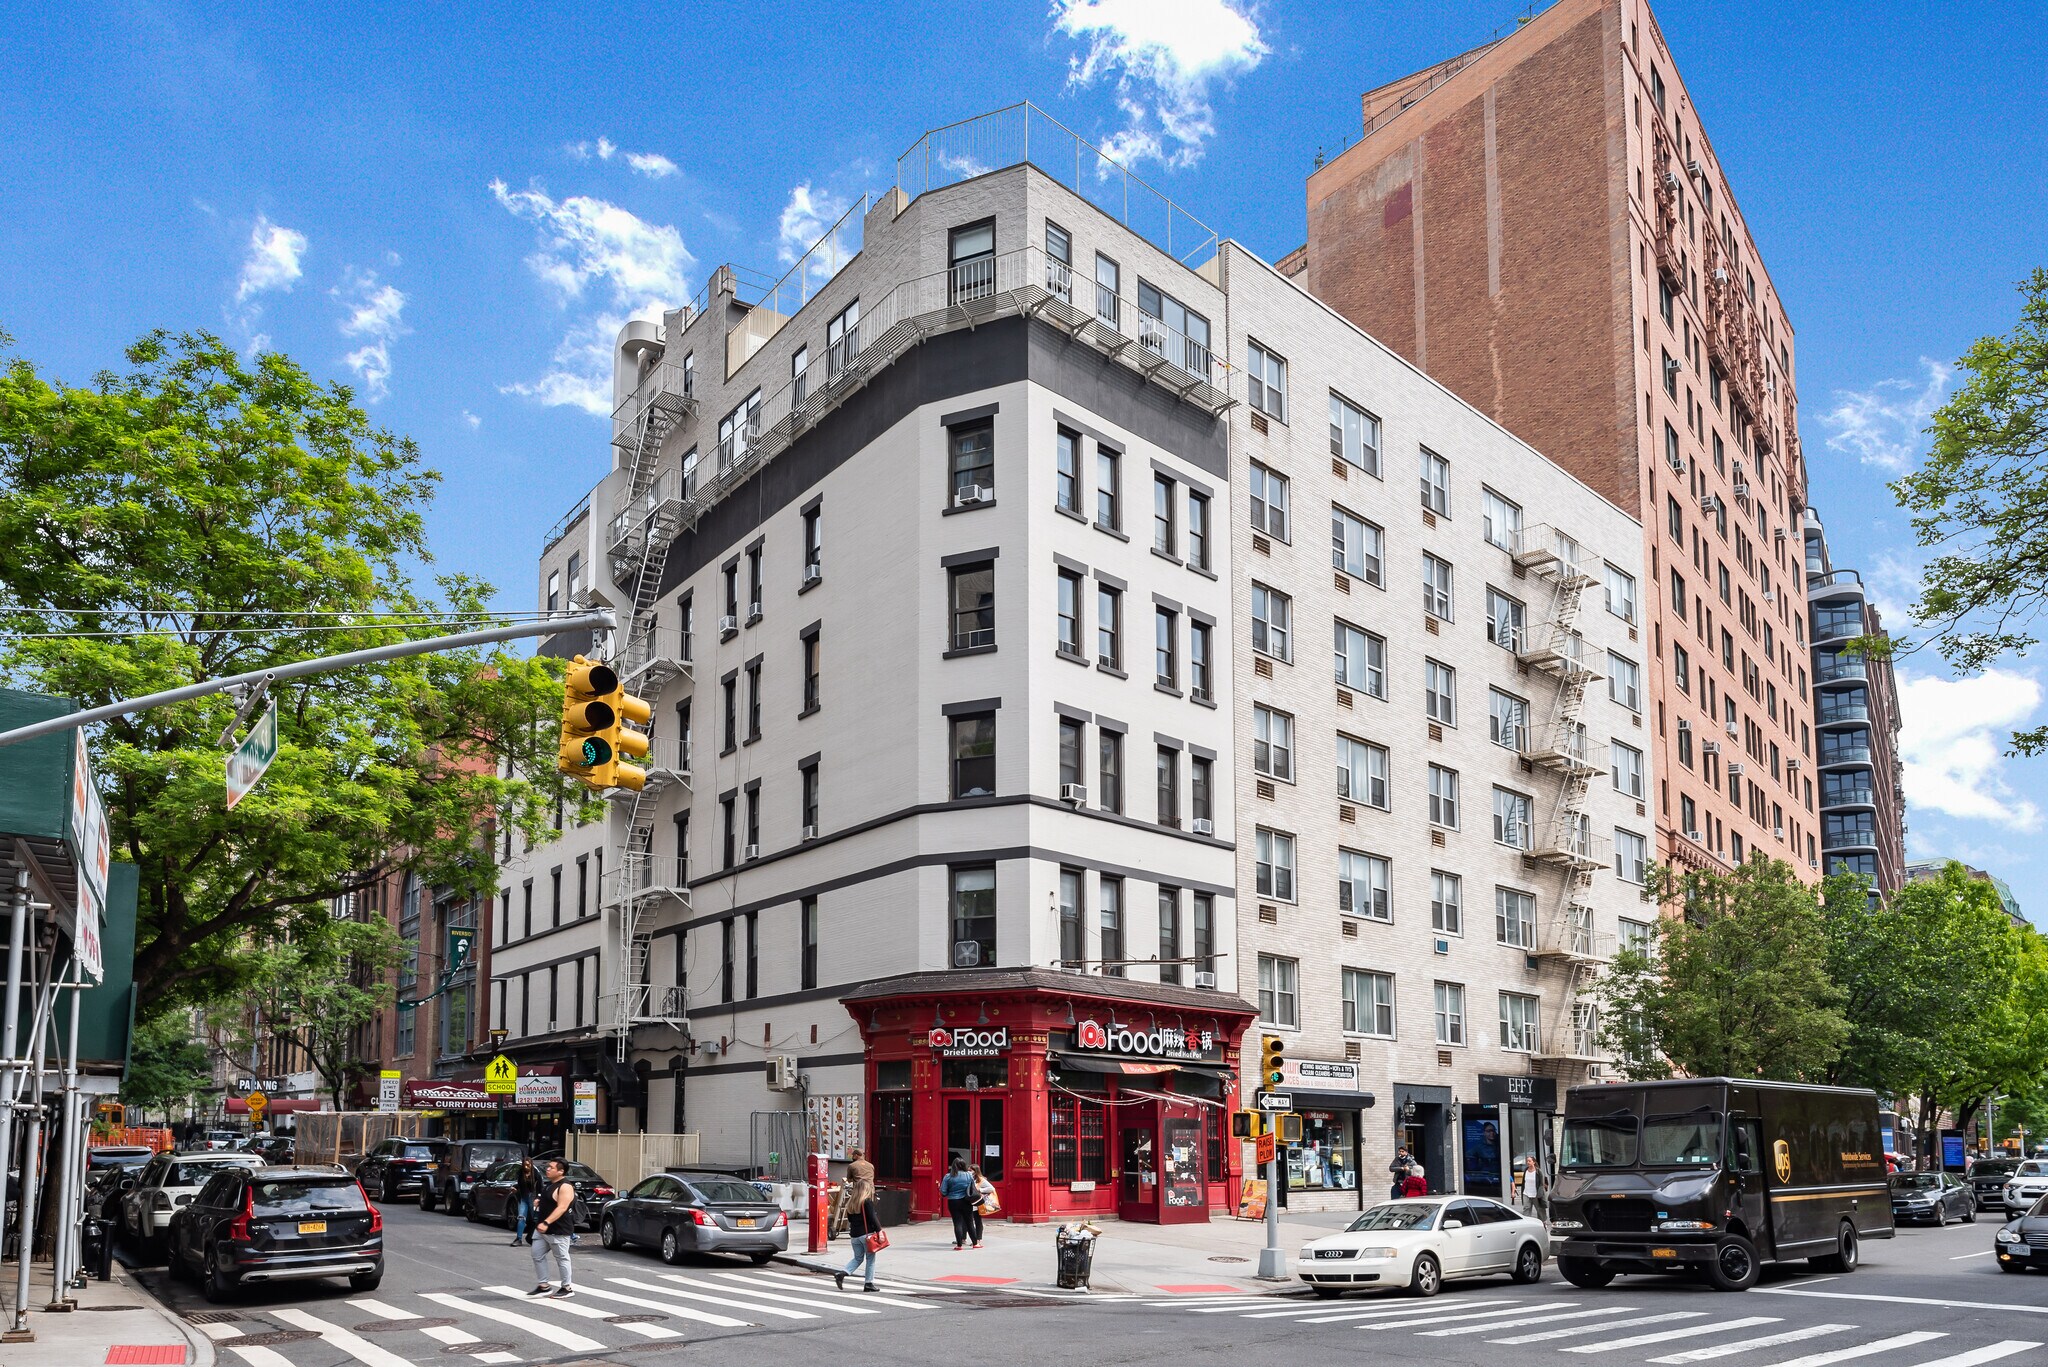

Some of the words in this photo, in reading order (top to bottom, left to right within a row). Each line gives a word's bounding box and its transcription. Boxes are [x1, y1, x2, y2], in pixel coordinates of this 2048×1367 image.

[236, 756, 244, 787] W
[246, 739, 259, 777] 108
[261, 725, 268, 759] St
[954, 1027, 1006, 1047] Food
[1107, 1023, 1163, 1055] Food
[943, 1048, 966, 1056] Dried
[967, 1048, 982, 1056] Hot
[984, 1048, 999, 1056] Pot
[1166, 1050, 1182, 1058] Dried
[1508, 1077, 1534, 1094] EFFY
[383, 1090, 396, 1099] 15
[1263, 1098, 1274, 1106] ONE
[1277, 1098, 1288, 1106] WAY
[1258, 1136, 1273, 1148] RAISE
[1259, 1148, 1273, 1160] PLOW
[1777, 1152, 1789, 1177] ups
